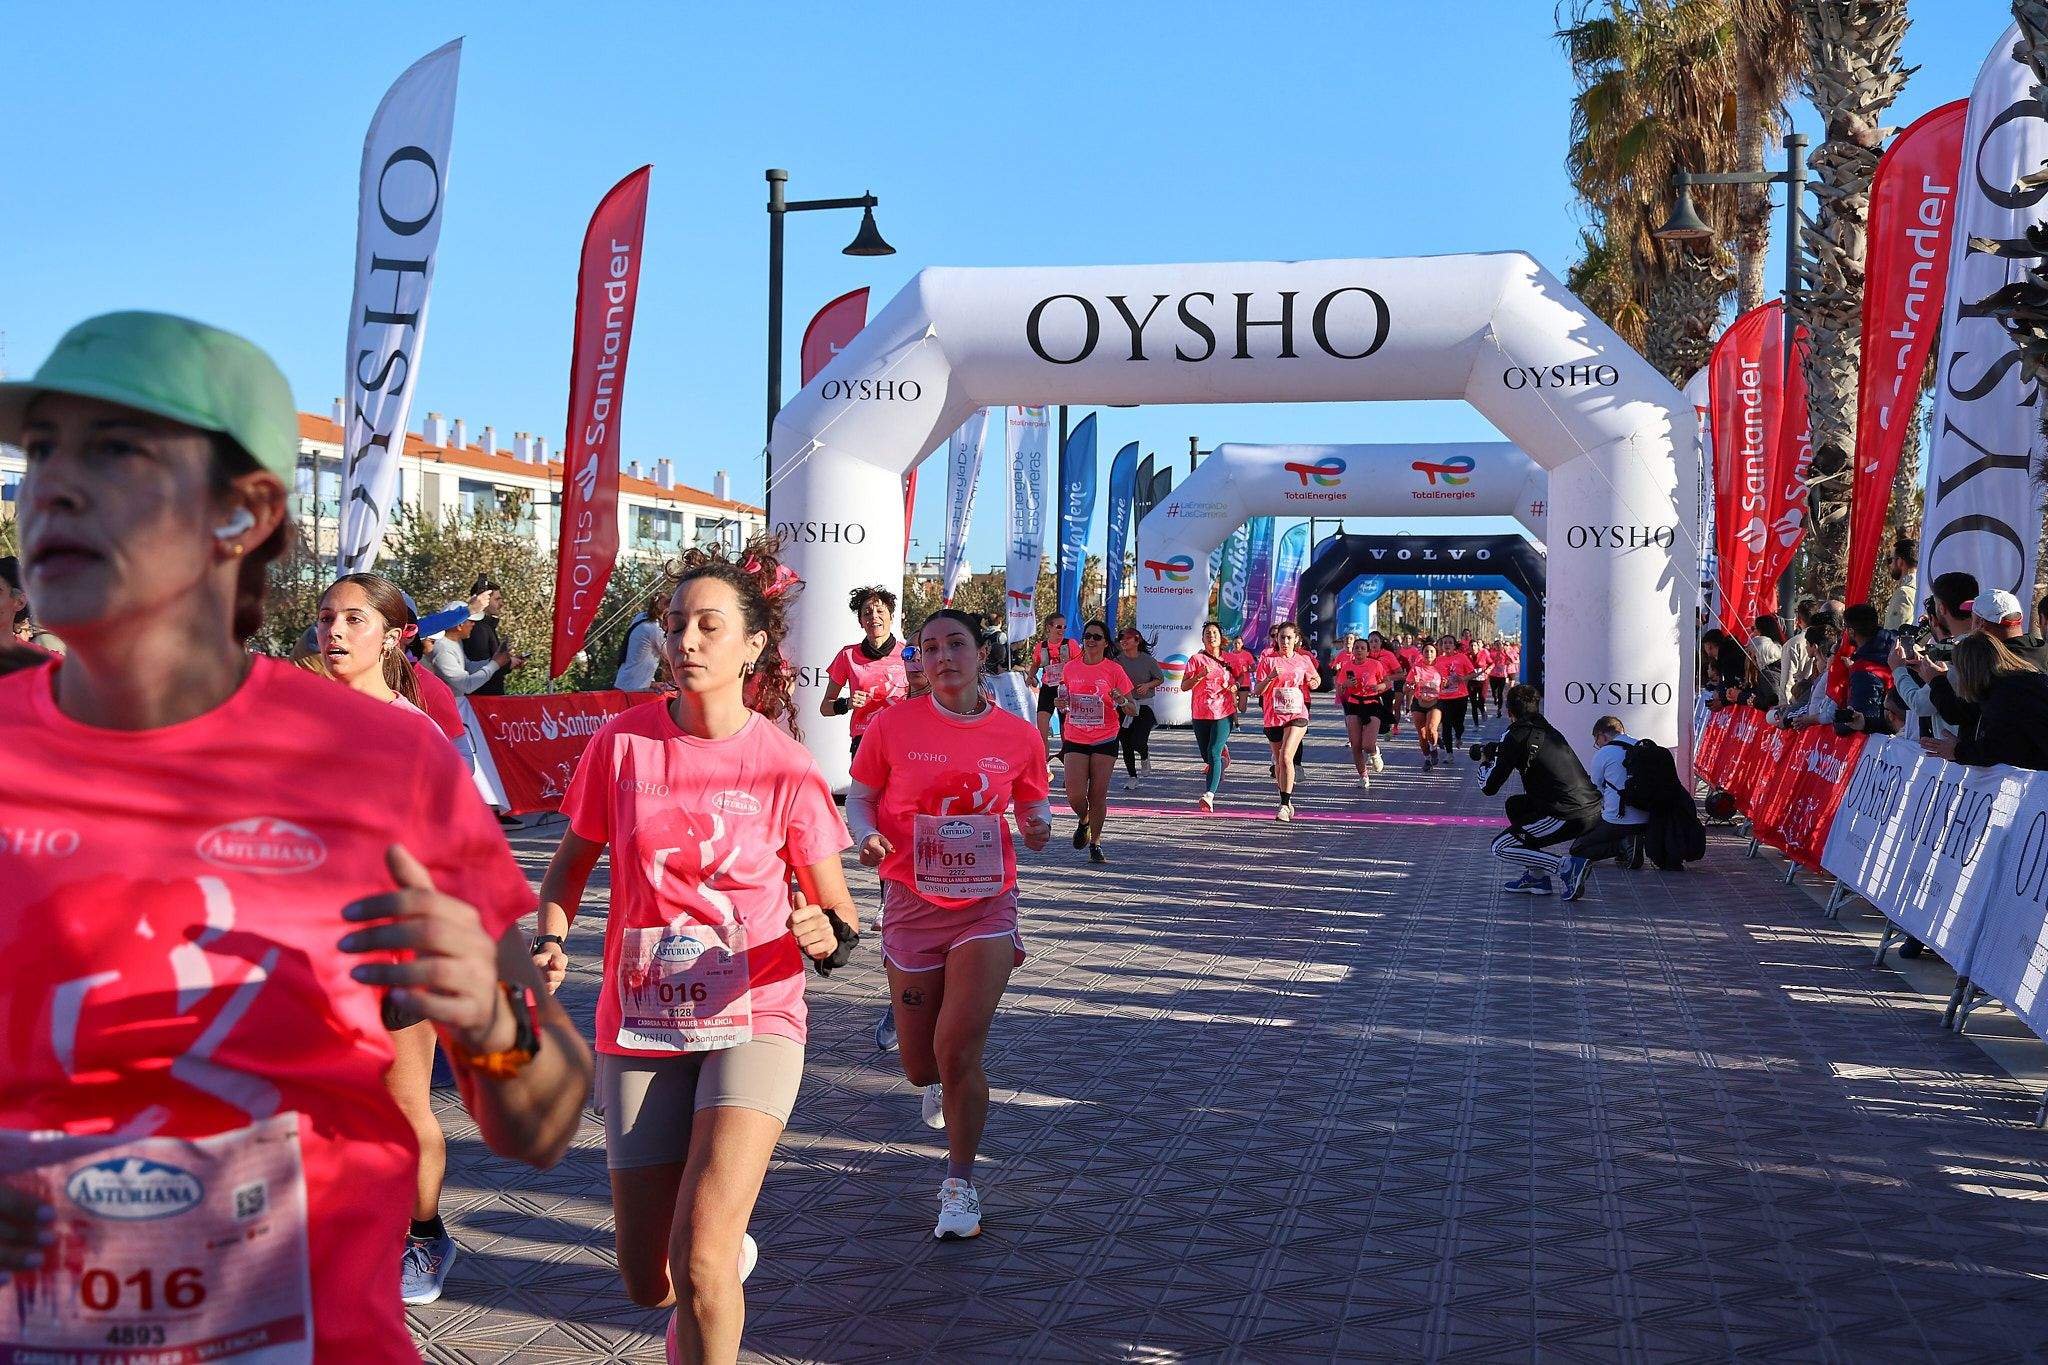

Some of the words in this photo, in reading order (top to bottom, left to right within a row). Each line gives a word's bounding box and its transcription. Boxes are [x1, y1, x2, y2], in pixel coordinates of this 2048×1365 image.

[1027, 287, 1389, 365] OYSHO
[586, 239, 630, 445] Santander
[1503, 364, 1619, 390] OYSHO
[821, 379, 922, 402] OYSHO
[1737, 358, 1766, 511] Santander
[1284, 491, 1347, 500] TotalEnergies
[1411, 490, 1475, 499] TotalEnergies
[776, 521, 866, 544] OYSHO
[1062, 481, 1087, 571] Marlene
[1567, 525, 1675, 549] OYSHO
[1369, 549, 1491, 560] VOLVO
[1144, 586, 1194, 595] TotalEnergies
[1310, 594, 1319, 658] OLVO
[1565, 681, 1672, 705] OYSHO
[908, 751, 947, 763] OYSHO
[620, 779, 670, 797] OYSHO
[1848, 754, 1902, 825] OYSHO
[1911, 776, 1993, 867] OYSHO
[942, 852, 976, 867] 016
[925, 884, 950, 893] OYSHO
[657, 944, 701, 956] ASTURIANA
[660, 982, 707, 1002] 016
[638, 1019, 661, 1027] CARRERA
[704, 1018, 733, 1026] VALENCIA
[669, 1009, 692, 1018] 2128
[633, 1032, 673, 1043] OYSHO
[695, 1033, 736, 1043] Santander
[77, 1178, 193, 1204] ASTURIANA
[81, 1267, 207, 1311] 016
[106, 1325, 166, 1346] 4893
